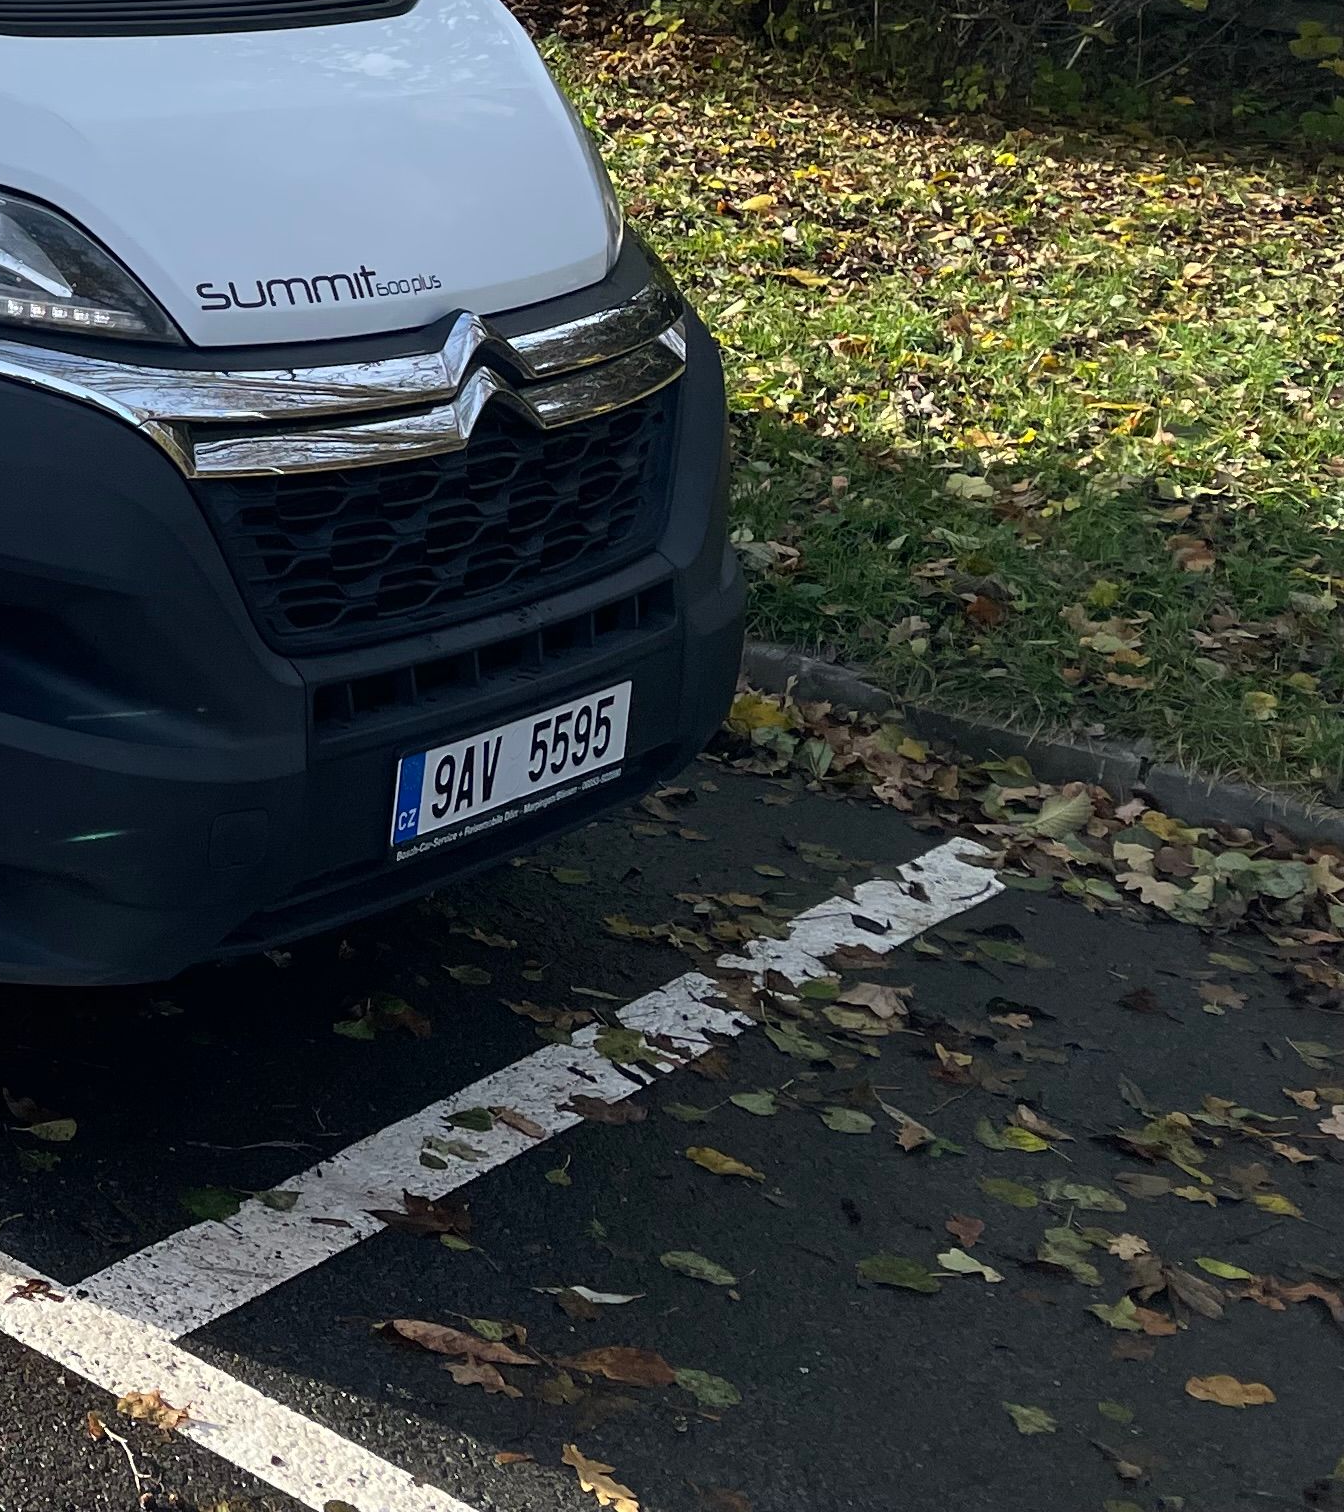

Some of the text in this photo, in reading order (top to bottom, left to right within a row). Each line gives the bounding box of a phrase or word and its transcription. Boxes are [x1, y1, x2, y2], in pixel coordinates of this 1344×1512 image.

[376, 280, 410, 296] 600
[411, 273, 442, 295] plus
[431, 695, 615, 819] 9AV 5595
[398, 808, 417, 831] CZ
